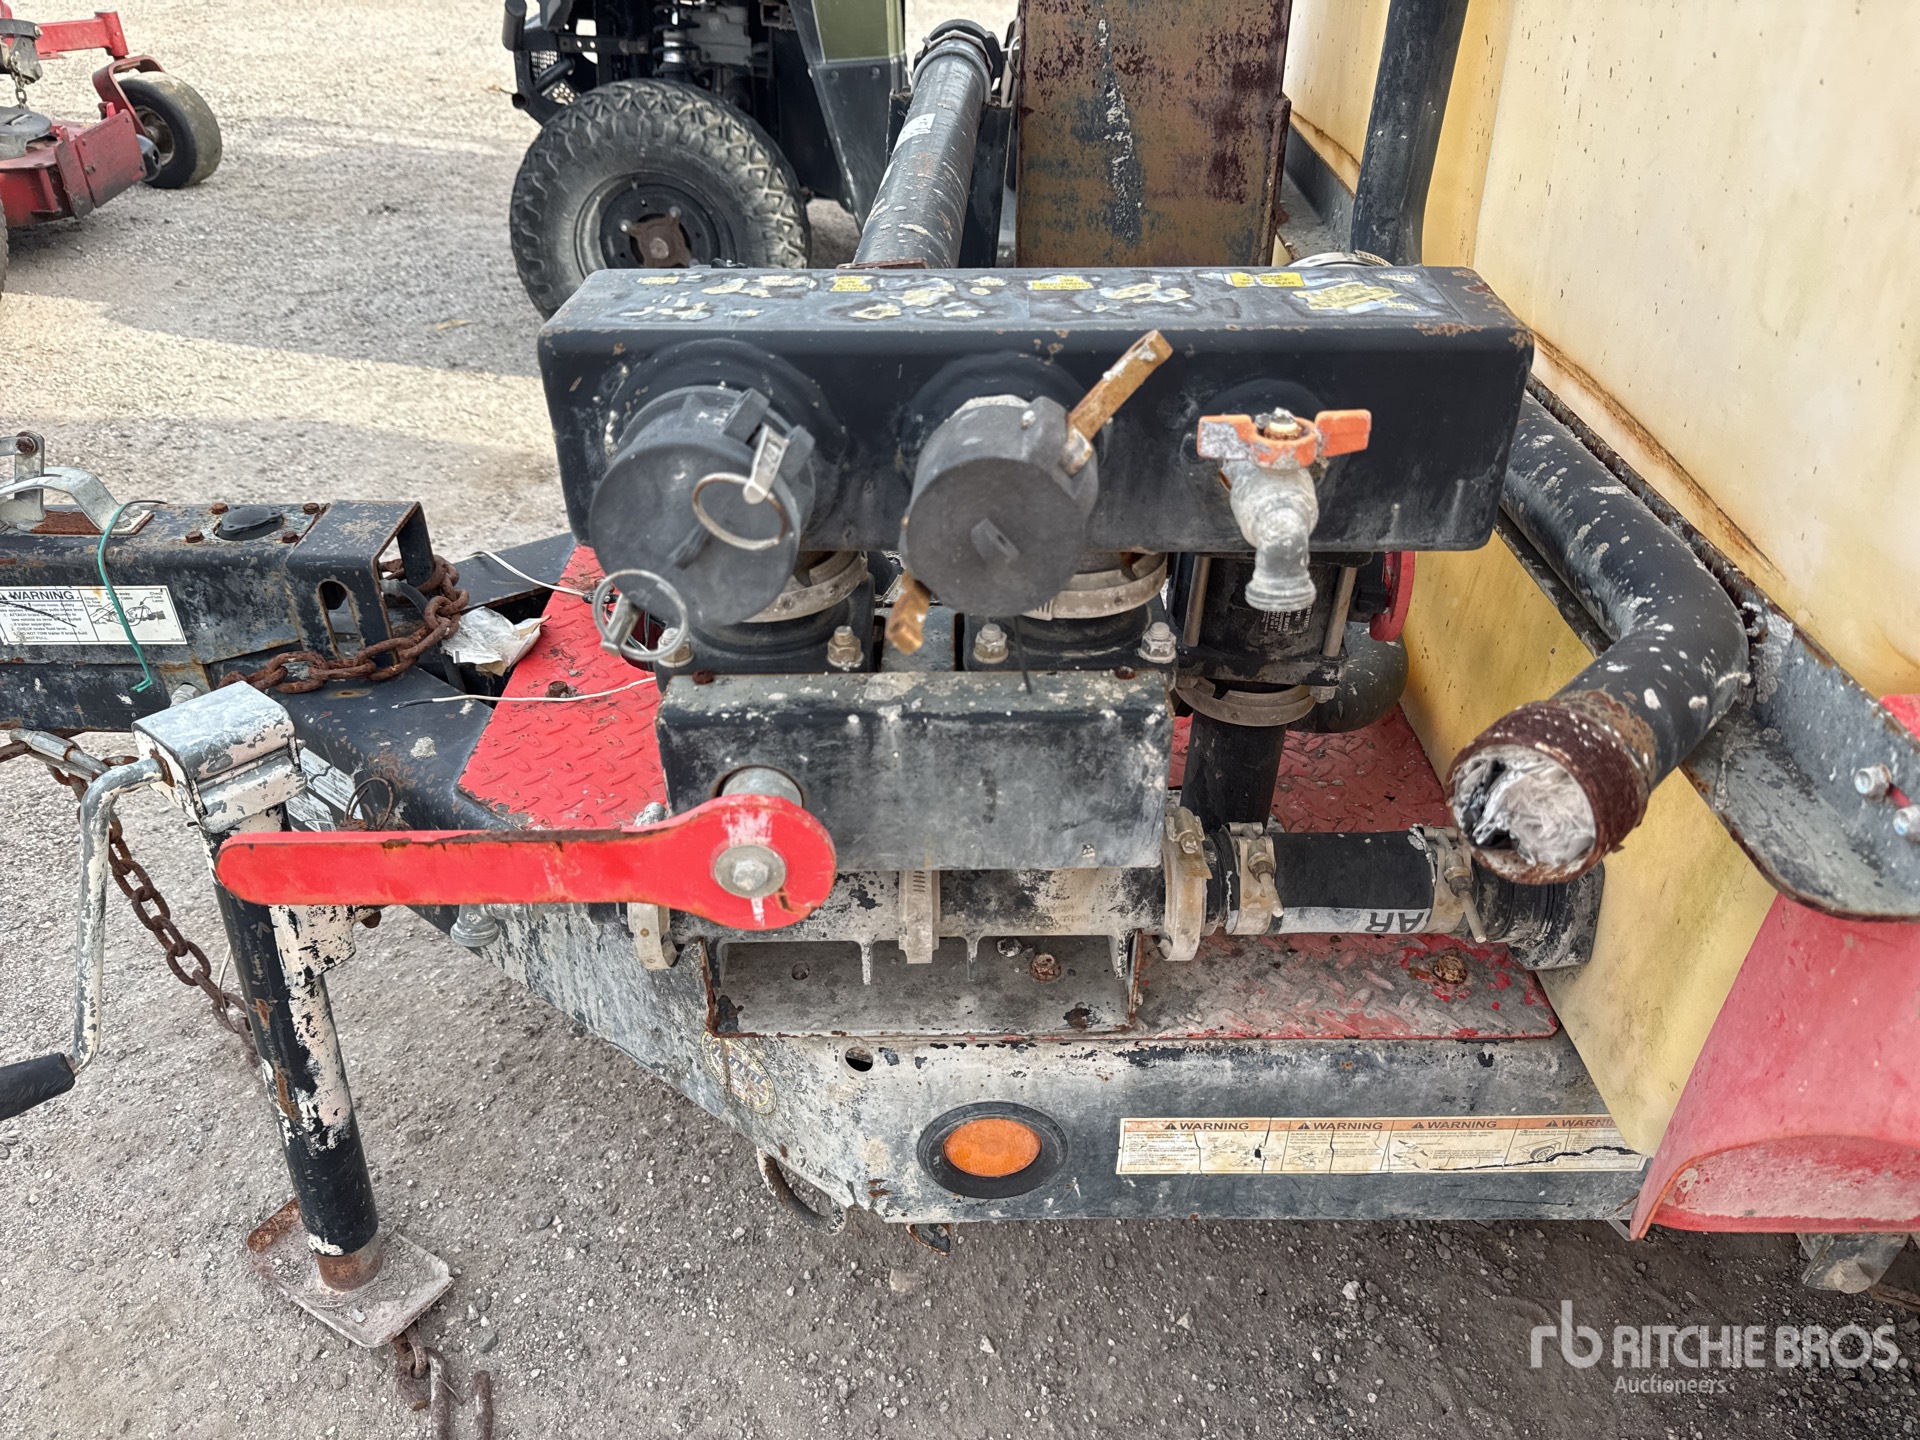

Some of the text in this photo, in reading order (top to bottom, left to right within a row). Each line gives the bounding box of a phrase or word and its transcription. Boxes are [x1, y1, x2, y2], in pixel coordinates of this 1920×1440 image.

[9, 591, 75, 600] WARNING
[1365, 912, 1430, 933] AR
[1180, 1122, 1249, 1130] WARNING
[1313, 1122, 1383, 1130] WARNING
[1428, 1120, 1497, 1129] WARNING
